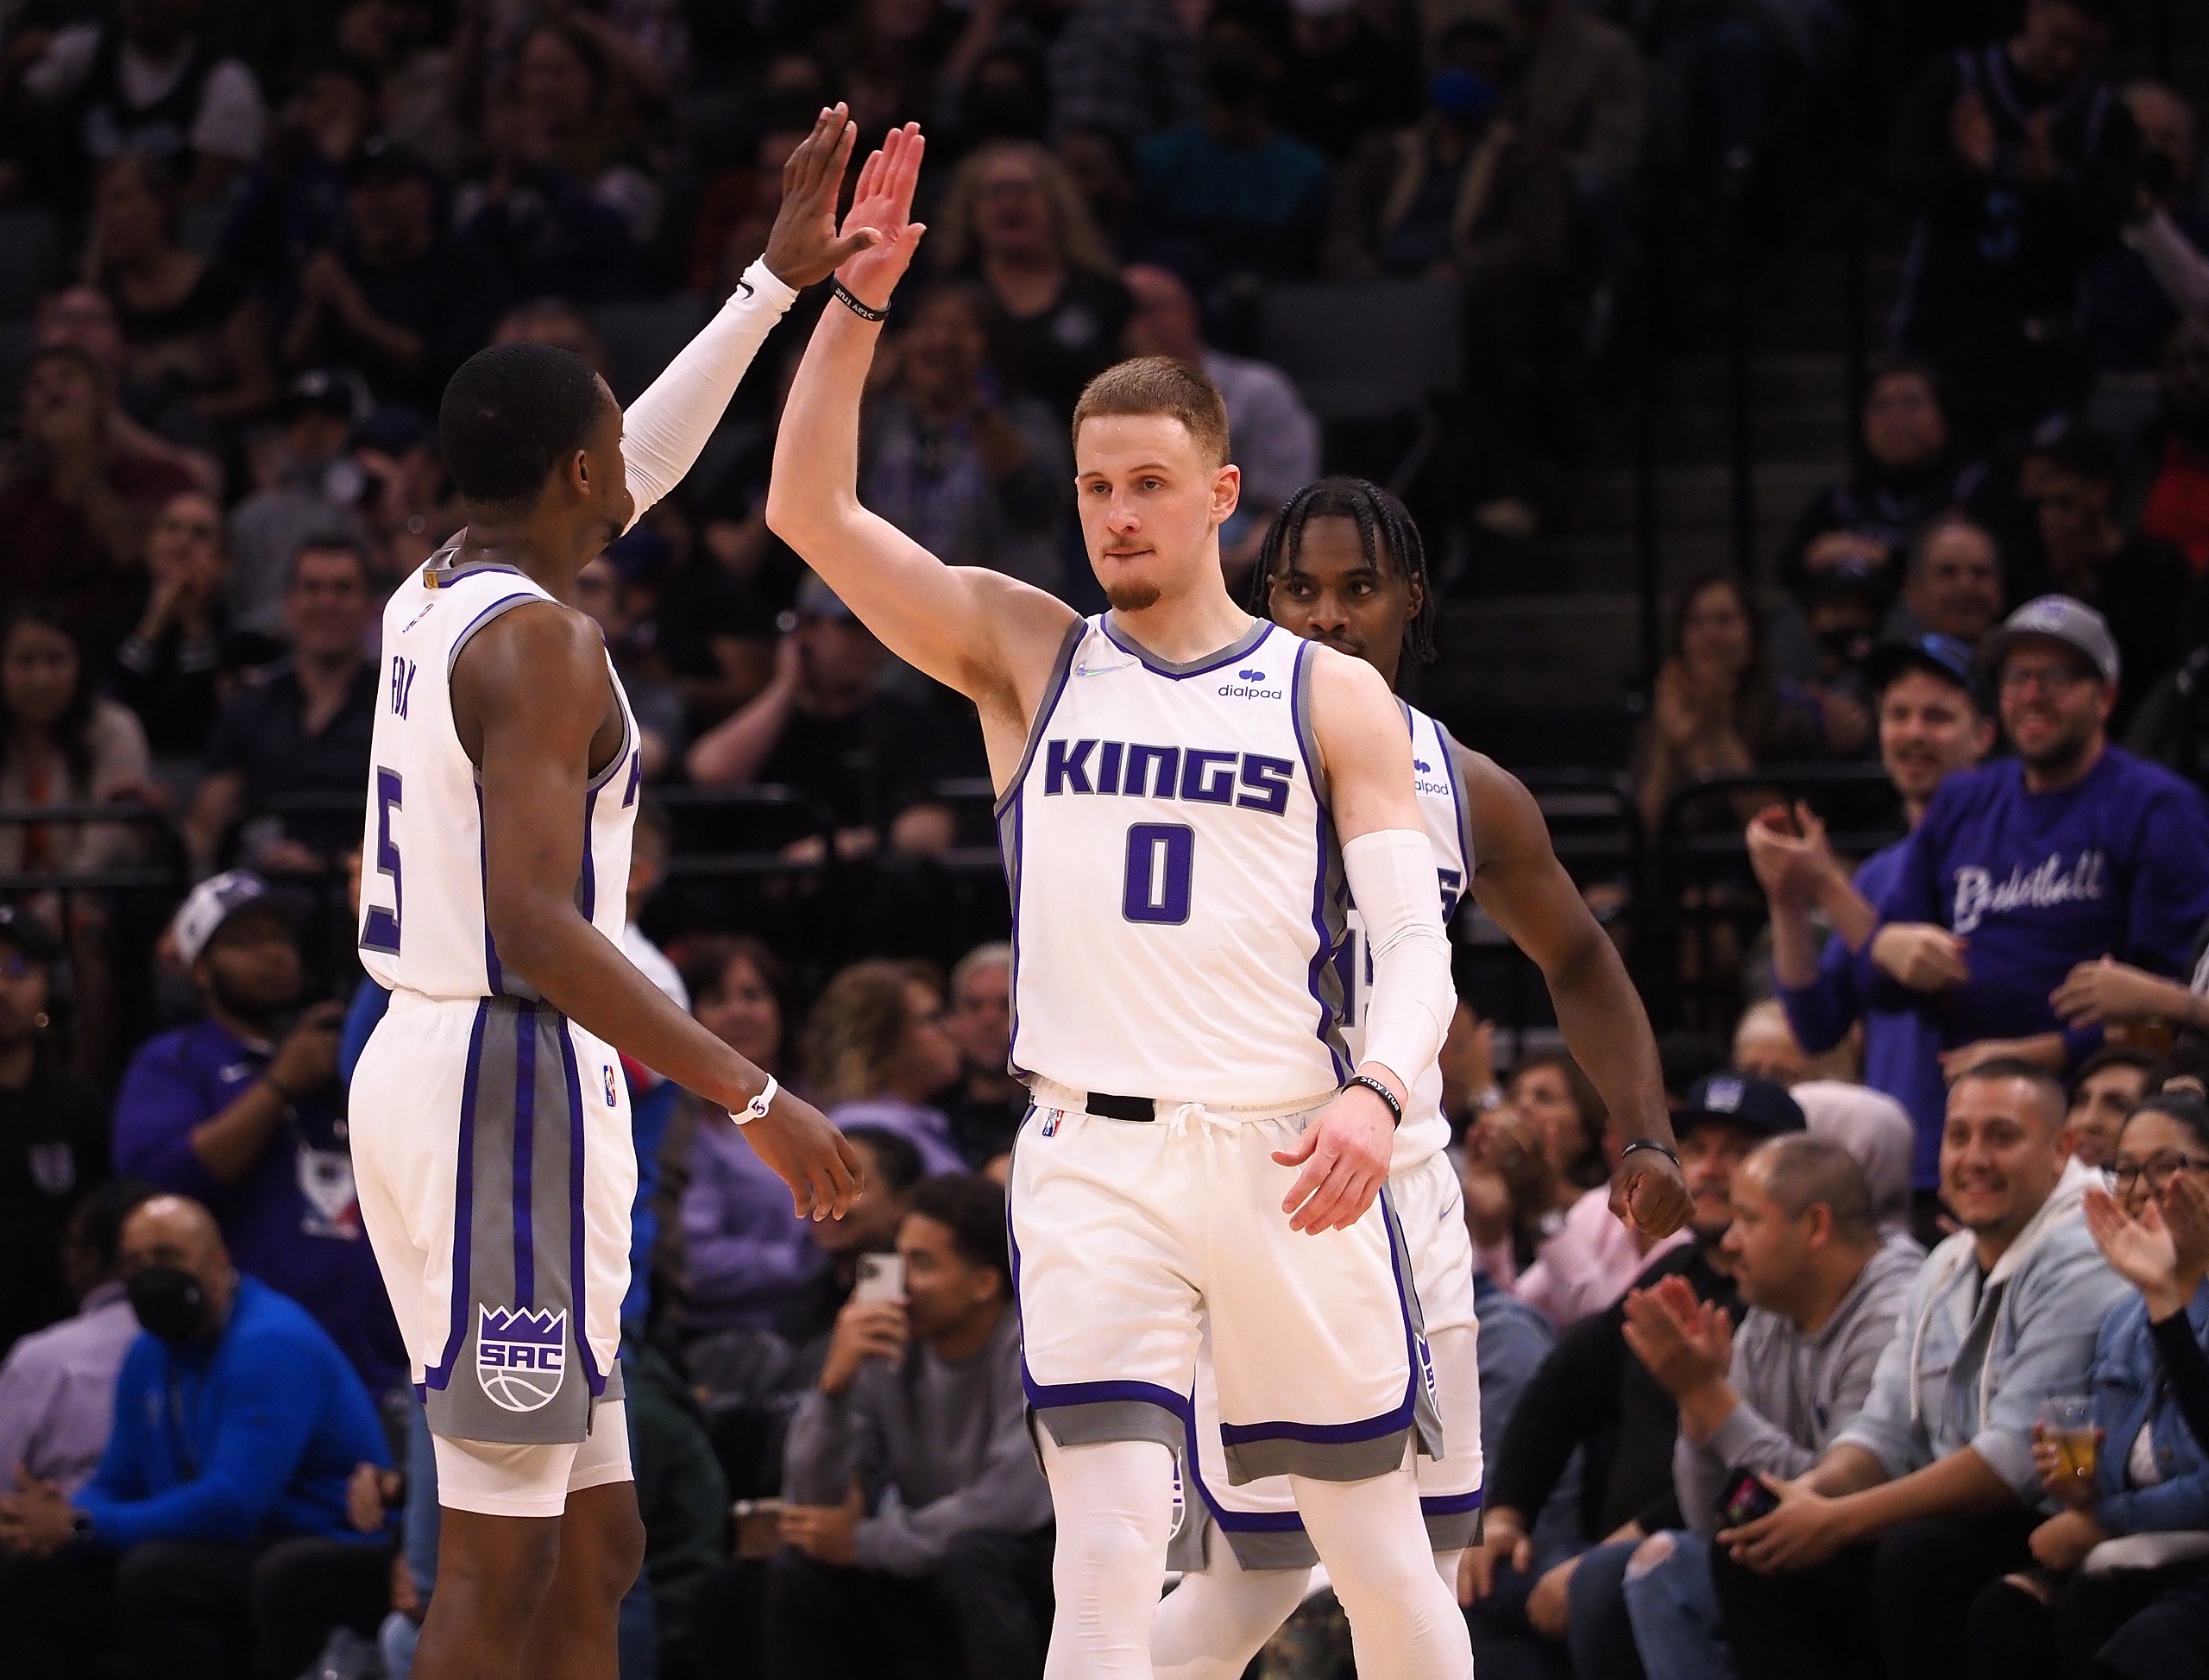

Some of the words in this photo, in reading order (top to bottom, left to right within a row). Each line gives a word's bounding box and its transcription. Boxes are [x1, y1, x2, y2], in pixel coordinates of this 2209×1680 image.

[834, 287, 853, 306] True
[852, 304, 875, 320] Stay
[391, 655, 417, 721] FOX
[1218, 684, 1282, 700] dialpad
[1043, 739, 1295, 817] KINGS
[1415, 779, 1449, 795] alpad
[358, 764, 403, 960] 5
[1122, 822, 1196, 926] 0
[1359, 1077, 1384, 1090] Stay
[1385, 1090, 1400, 1111] True
[479, 1343, 563, 1370] SAC
